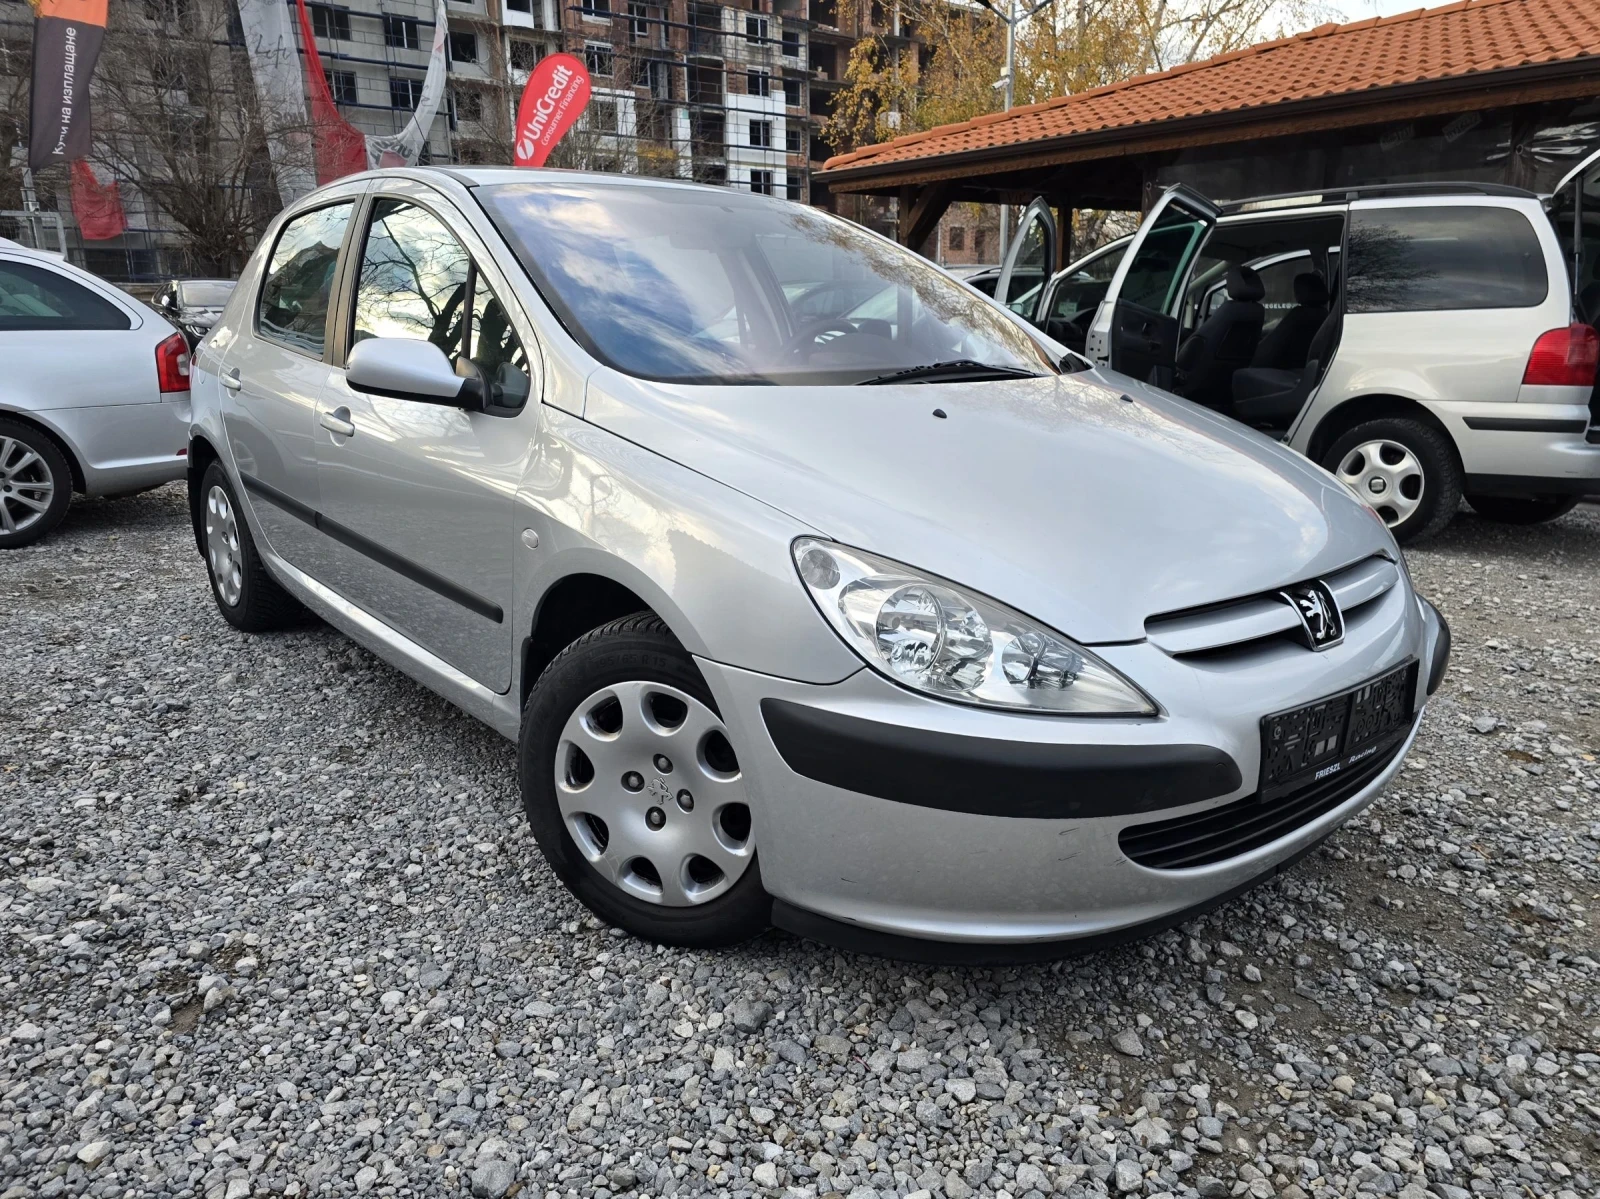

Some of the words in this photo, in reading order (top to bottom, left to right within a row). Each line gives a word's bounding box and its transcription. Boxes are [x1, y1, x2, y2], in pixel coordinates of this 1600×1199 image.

[63, 27, 77, 105] изплащане
[62, 107, 72, 123] на
[523, 64, 573, 140] UniCredit
[541, 109, 564, 146] Consumer
[560, 75, 585, 111] Financing
[1314, 762, 1341, 780] FRIESZL
[1348, 746, 1377, 764] Racing
